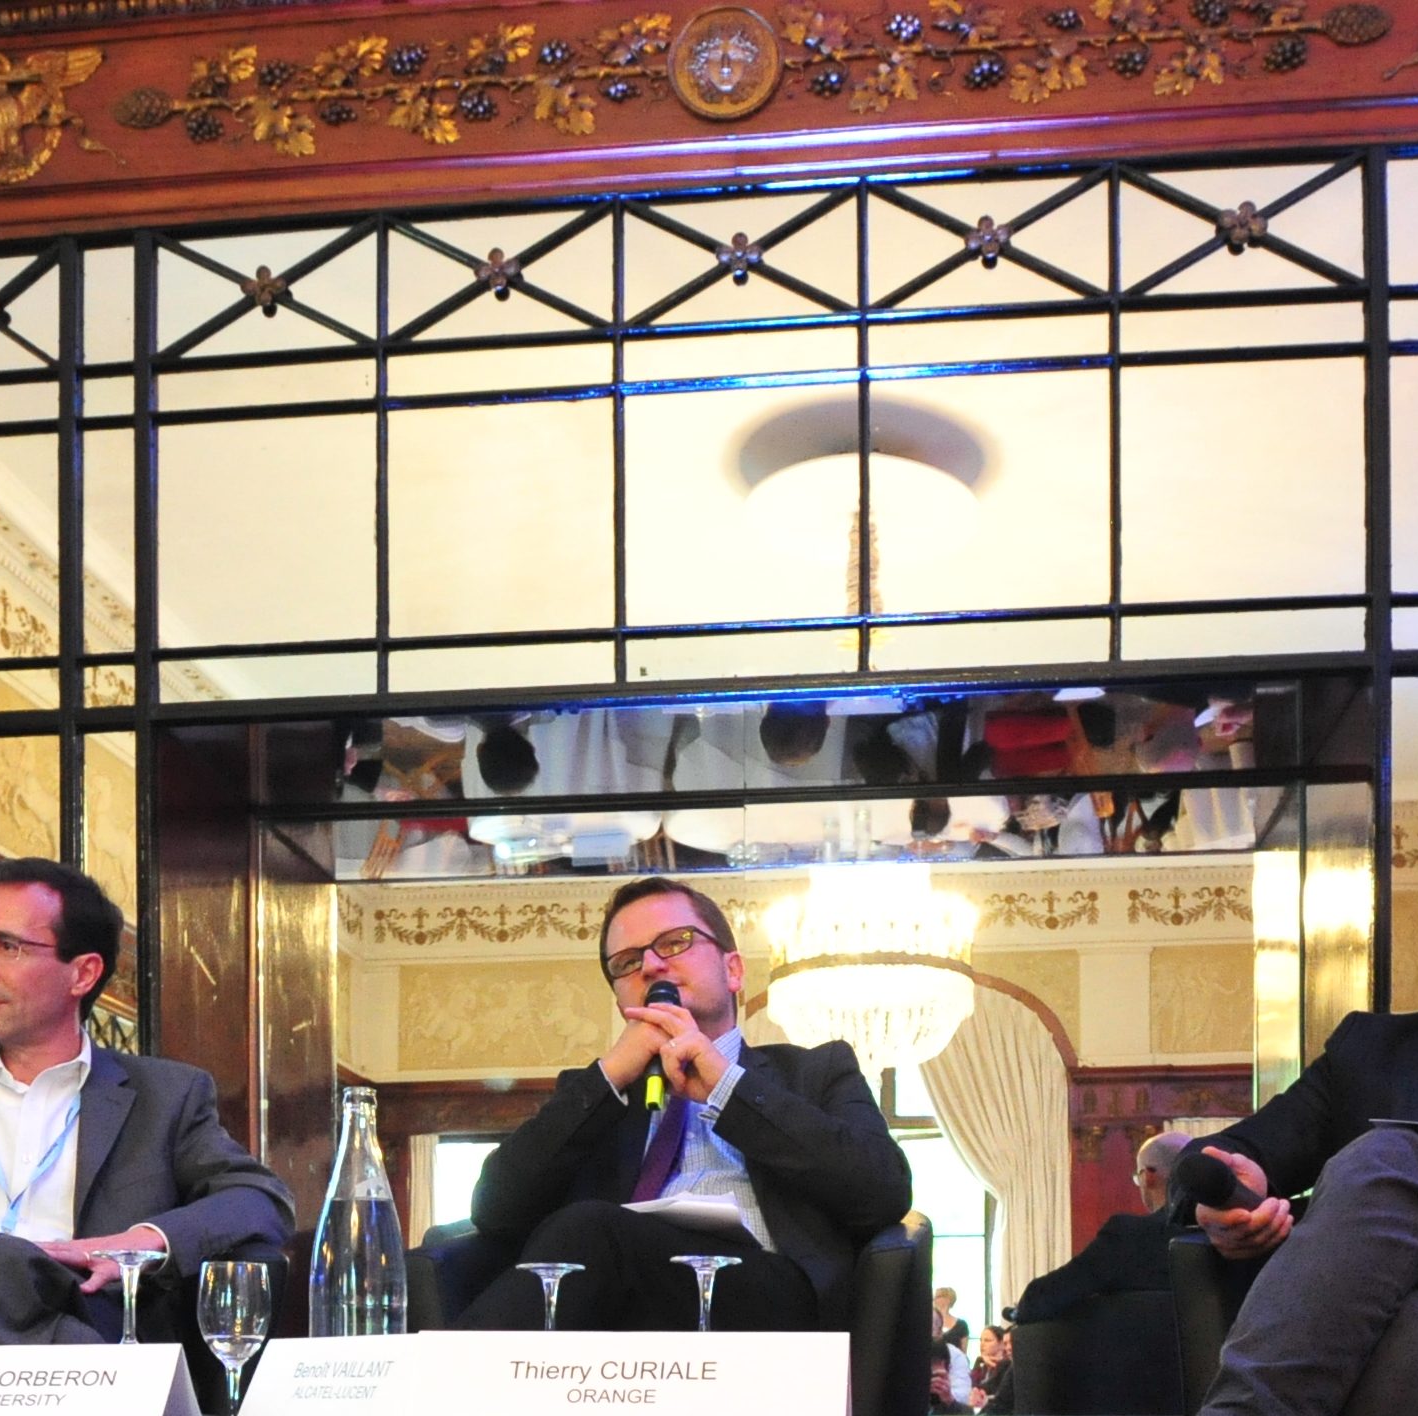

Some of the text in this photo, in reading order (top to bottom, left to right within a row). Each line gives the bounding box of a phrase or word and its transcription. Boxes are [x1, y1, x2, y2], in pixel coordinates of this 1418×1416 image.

[333, 1360, 395, 1378] VAILLANT
[511, 1360, 717, 1386] Thierry CURIALE
[292, 1385, 377, 1399] ALCATEL-LUCENT
[566, 1388, 657, 1404] ORANGE
